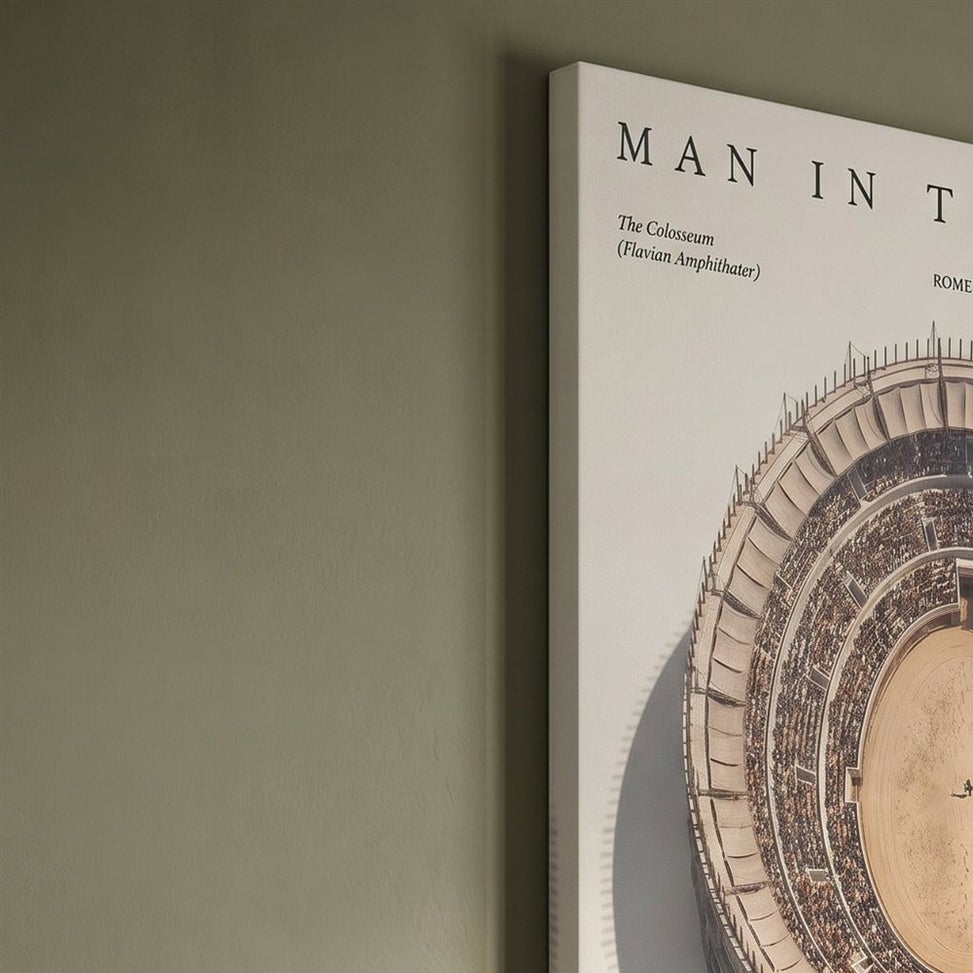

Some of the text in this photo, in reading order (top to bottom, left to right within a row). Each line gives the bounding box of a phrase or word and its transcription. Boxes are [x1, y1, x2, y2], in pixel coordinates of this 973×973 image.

[617, 121, 758, 187] MAN
[811, 160, 876, 210] IN
[618, 215, 714, 247] The Colosseum
[617, 236, 760, 282] (Flavian Amphithater)
[934, 274, 972, 293] ROME
